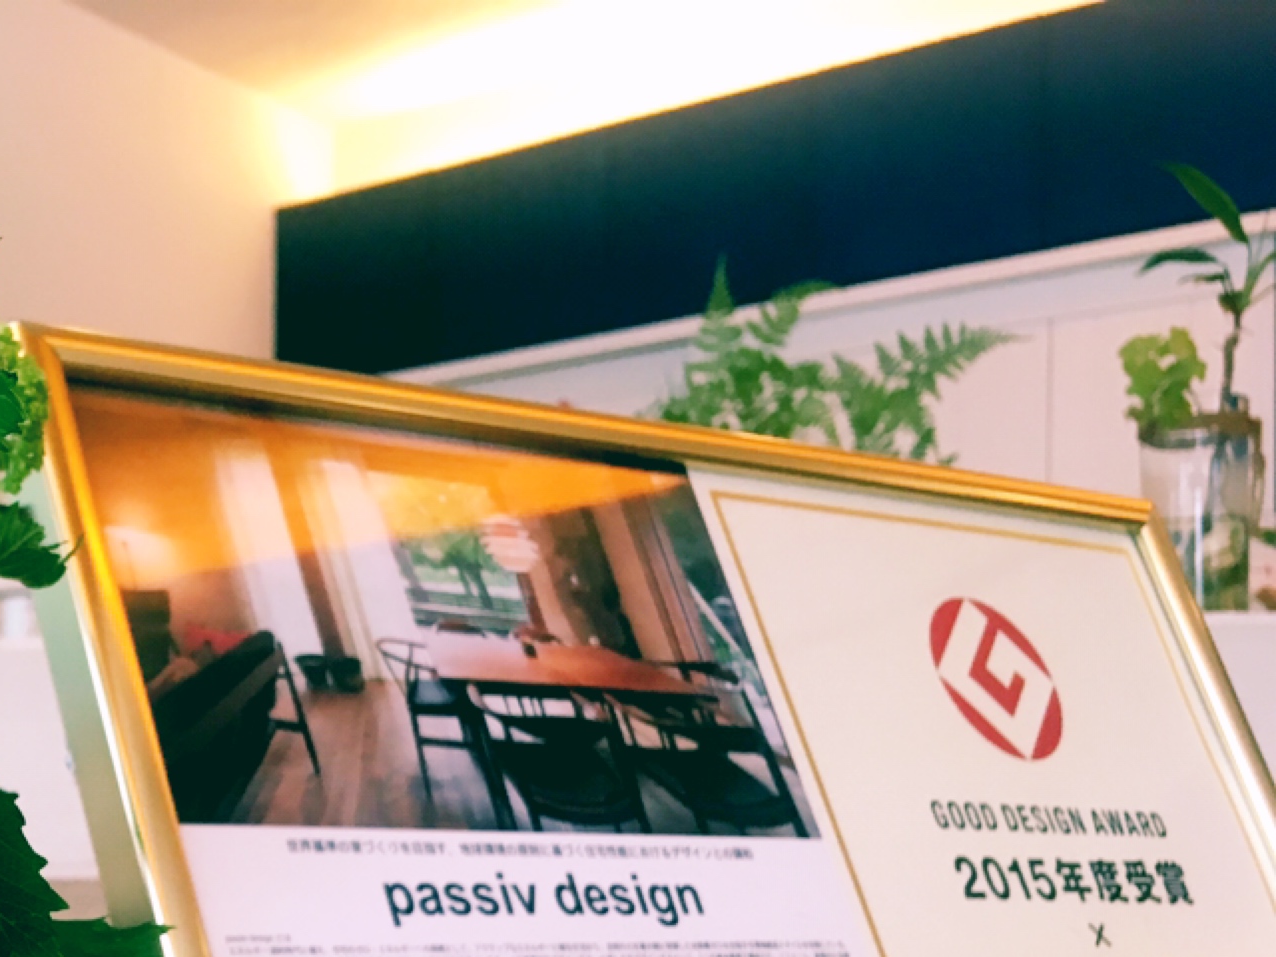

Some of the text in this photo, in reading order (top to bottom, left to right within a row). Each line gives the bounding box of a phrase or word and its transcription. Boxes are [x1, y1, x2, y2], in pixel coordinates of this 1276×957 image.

[930, 799, 1168, 838] GOOD DESIGN AWARD
[382, 871, 705, 928] passiv design
[954, 855, 1194, 905] 2015年度受賞
